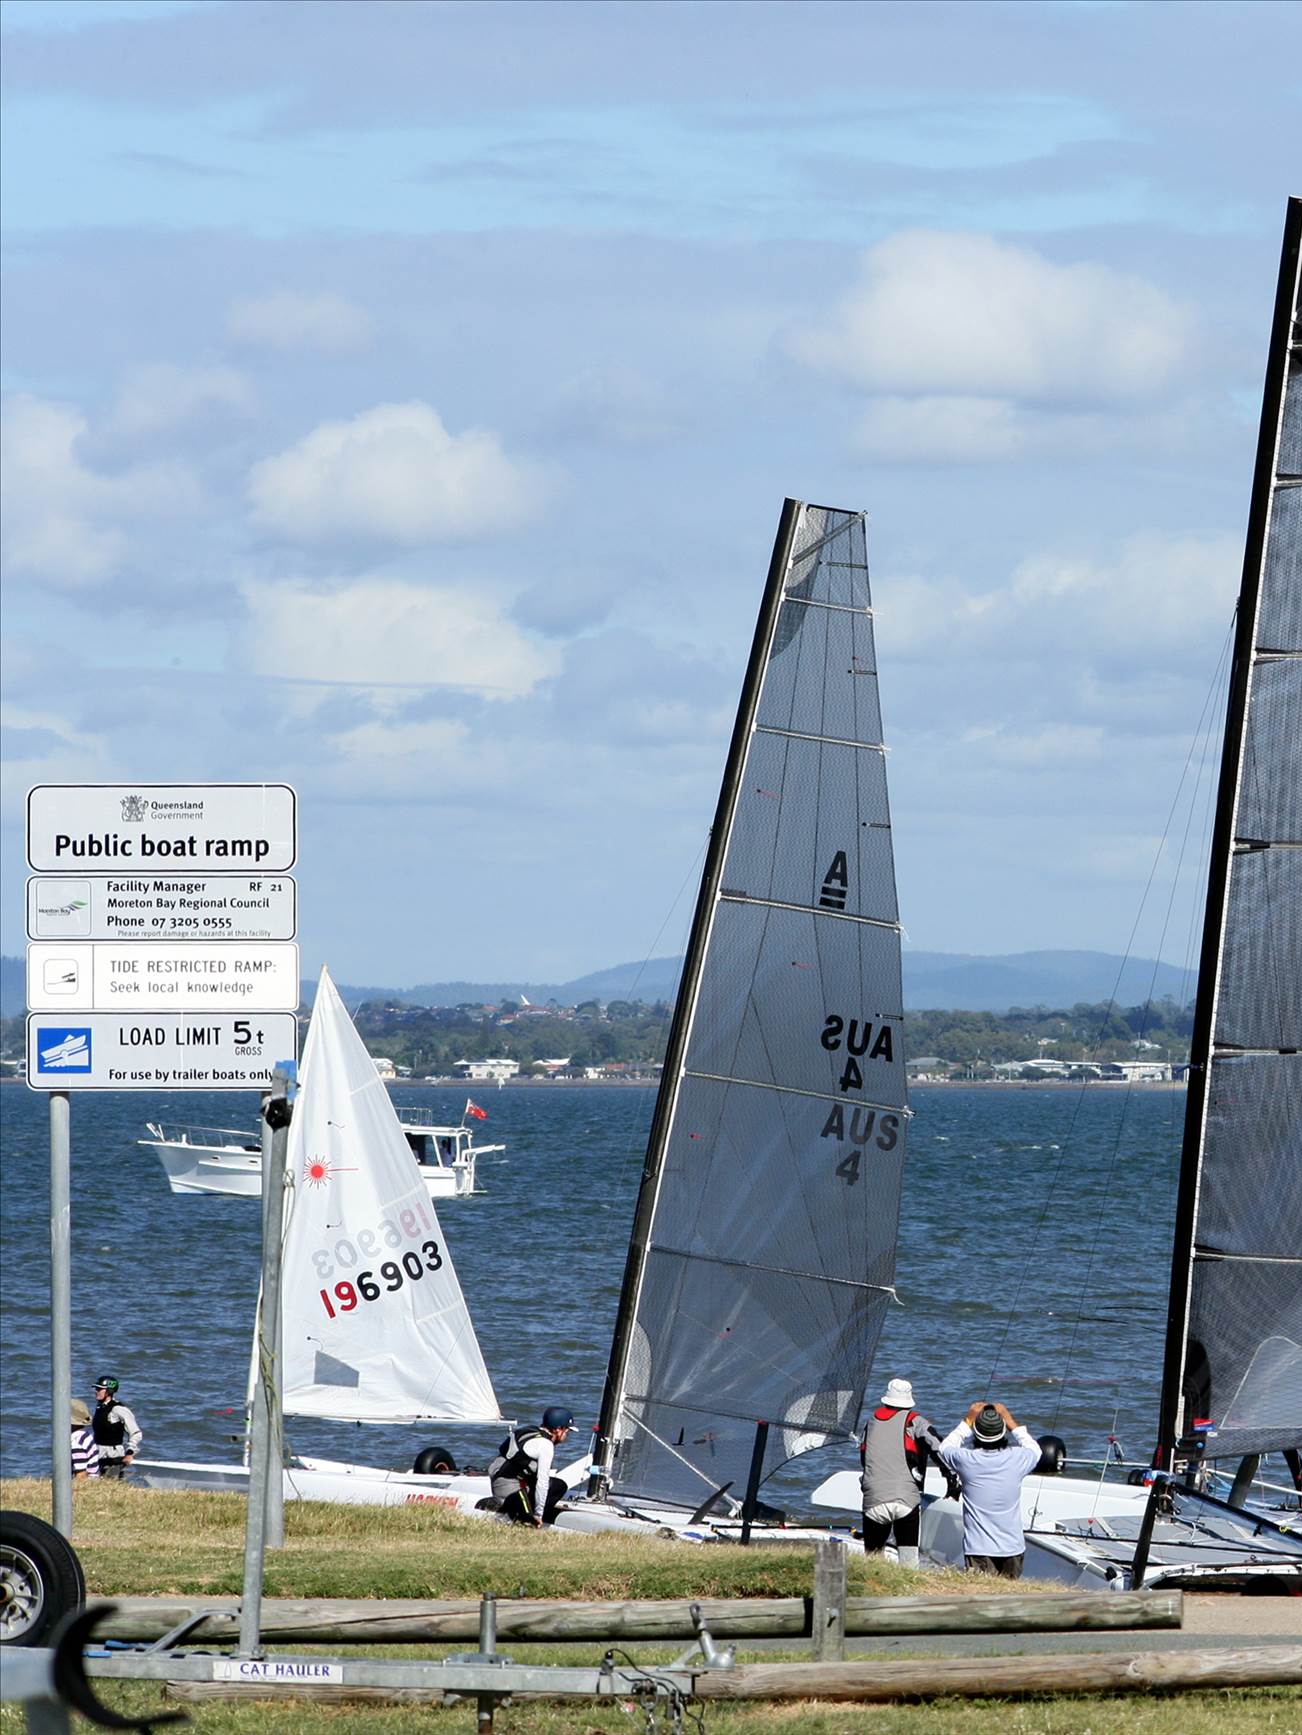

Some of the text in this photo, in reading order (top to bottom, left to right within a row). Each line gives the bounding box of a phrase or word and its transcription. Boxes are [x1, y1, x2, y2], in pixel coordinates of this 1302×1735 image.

[151, 801, 203, 810] Queensland
[151, 810, 203, 820] Government
[56, 834, 269, 862] Public boat ramp
[824, 850, 848, 887] A
[108, 881, 206, 894] Facility Manager
[249, 882, 283, 892] RF 21
[108, 898, 269, 910] Moreton Bay Regional Council
[107, 916, 231, 928] Phone 07 3205 0555
[141, 929, 161, 938] report
[163, 930, 189, 938] damage
[249, 929, 271, 938] facility
[111, 960, 138, 973] TIDE
[147, 960, 226, 973] RESTRICTED
[110, 981, 253, 996] Seek local knowledge
[120, 1028, 165, 1045] LOAD
[176, 1028, 221, 1045] LIMIT
[235, 1047, 261, 1055] GROSS
[110, 1069, 273, 1082] For use by trailer boats only
[820, 1103, 900, 1152] AUS
[835, 1149, 862, 1186] 4
[320, 1240, 443, 1319] 196903
[240, 1663, 330, 1677] CAT HAULER
